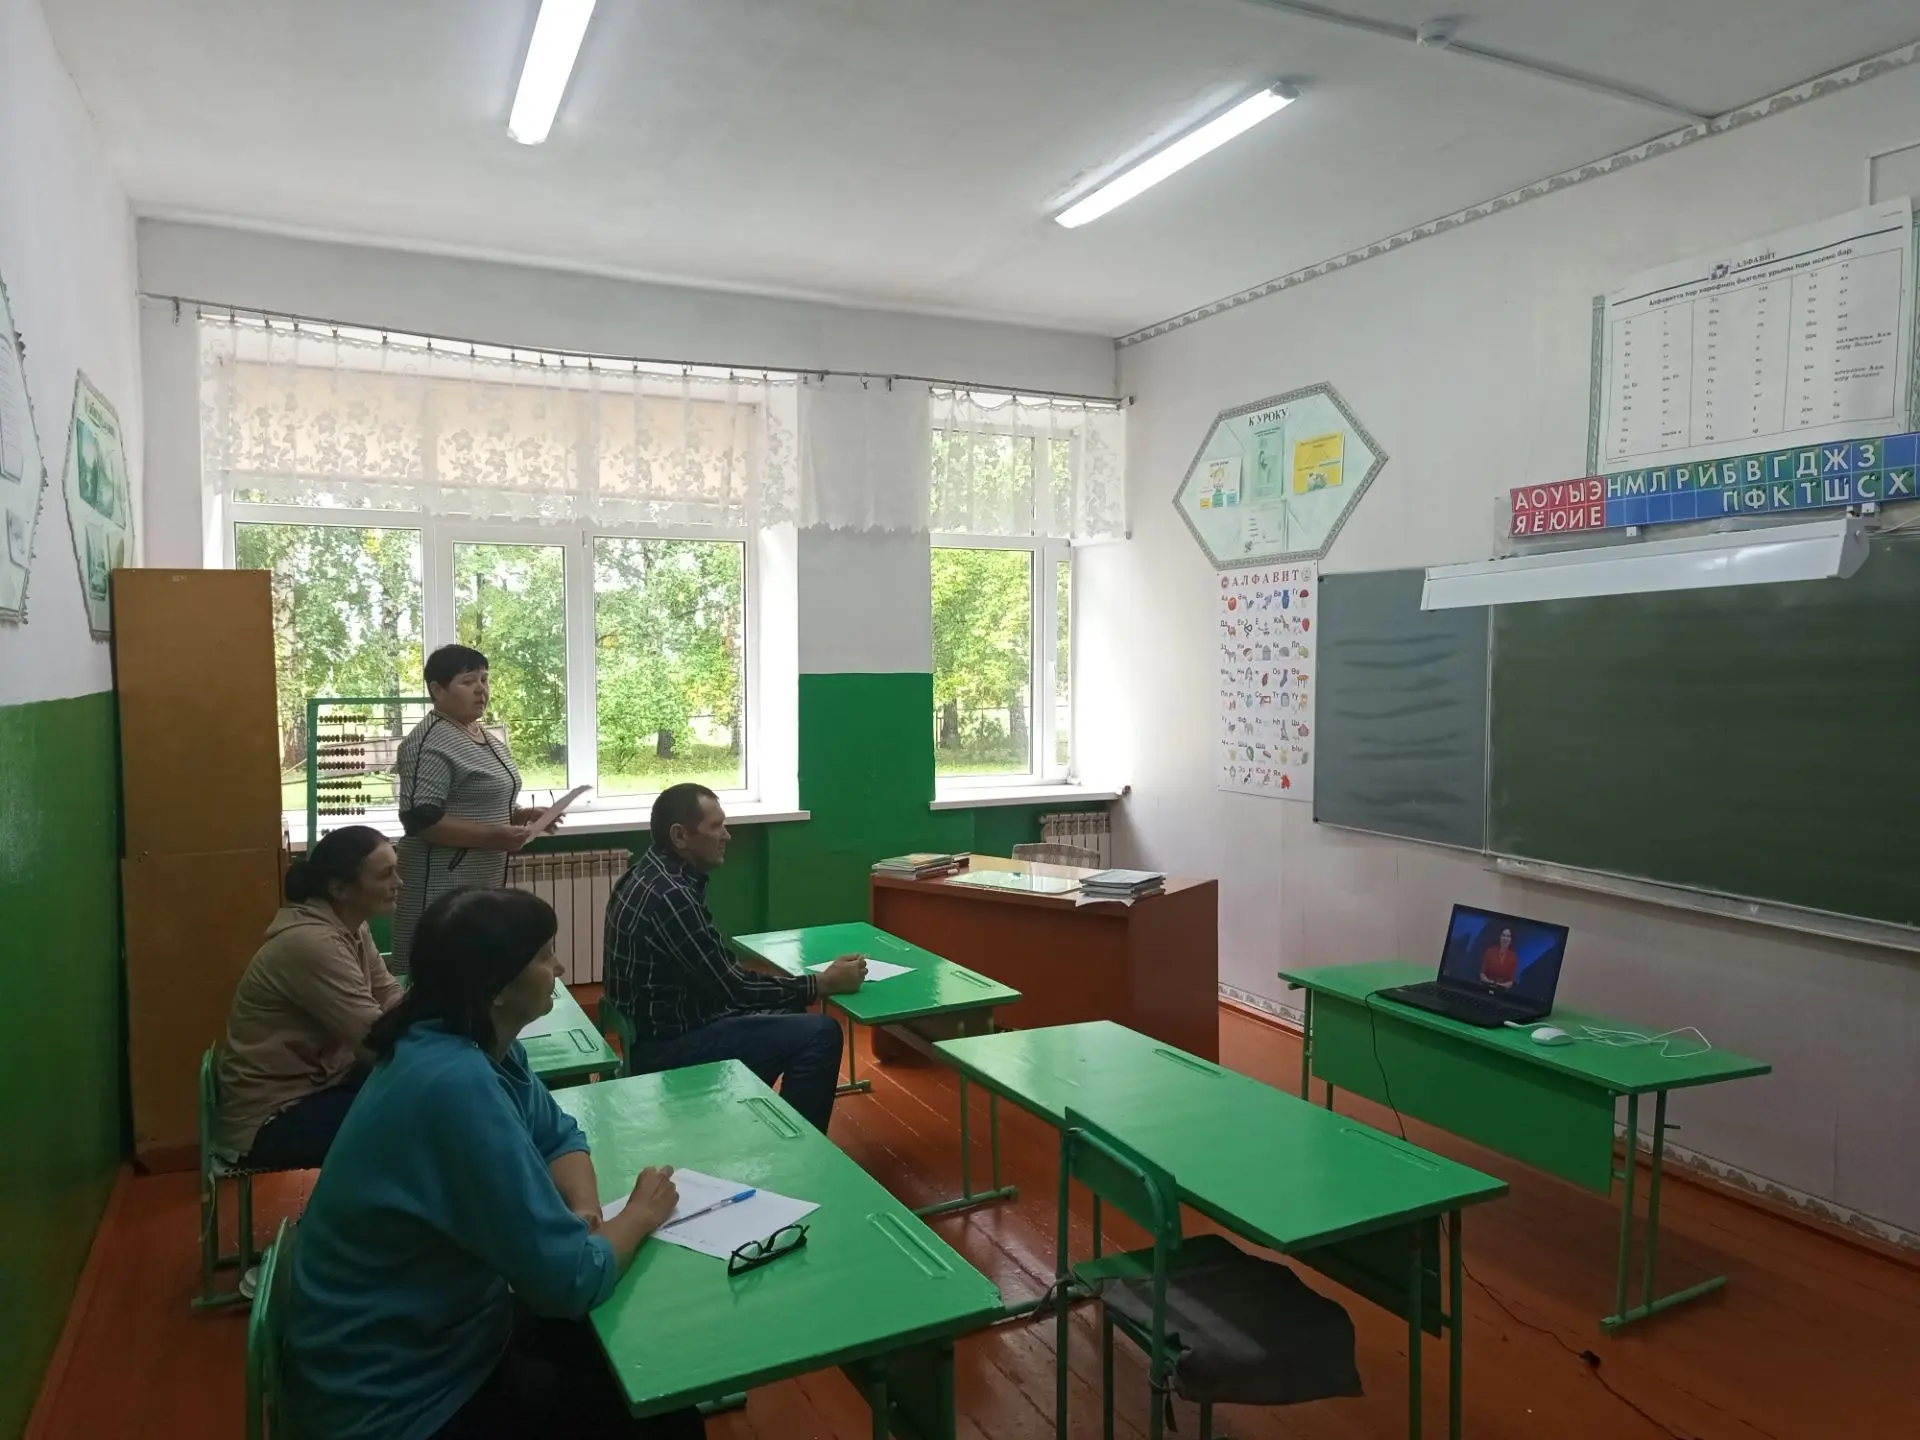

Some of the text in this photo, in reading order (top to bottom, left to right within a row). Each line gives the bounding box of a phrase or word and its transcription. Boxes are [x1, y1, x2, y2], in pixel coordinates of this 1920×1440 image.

[1514, 472, 1910, 533] Я Ё Ю И Е П Ф К Т Ш С Х
[1516, 444, 1875, 510] А О У Ы Э Н М Л Р Й Б В Г Д Ж З
[1232, 569, 1299, 587] АЛФАВИТ
